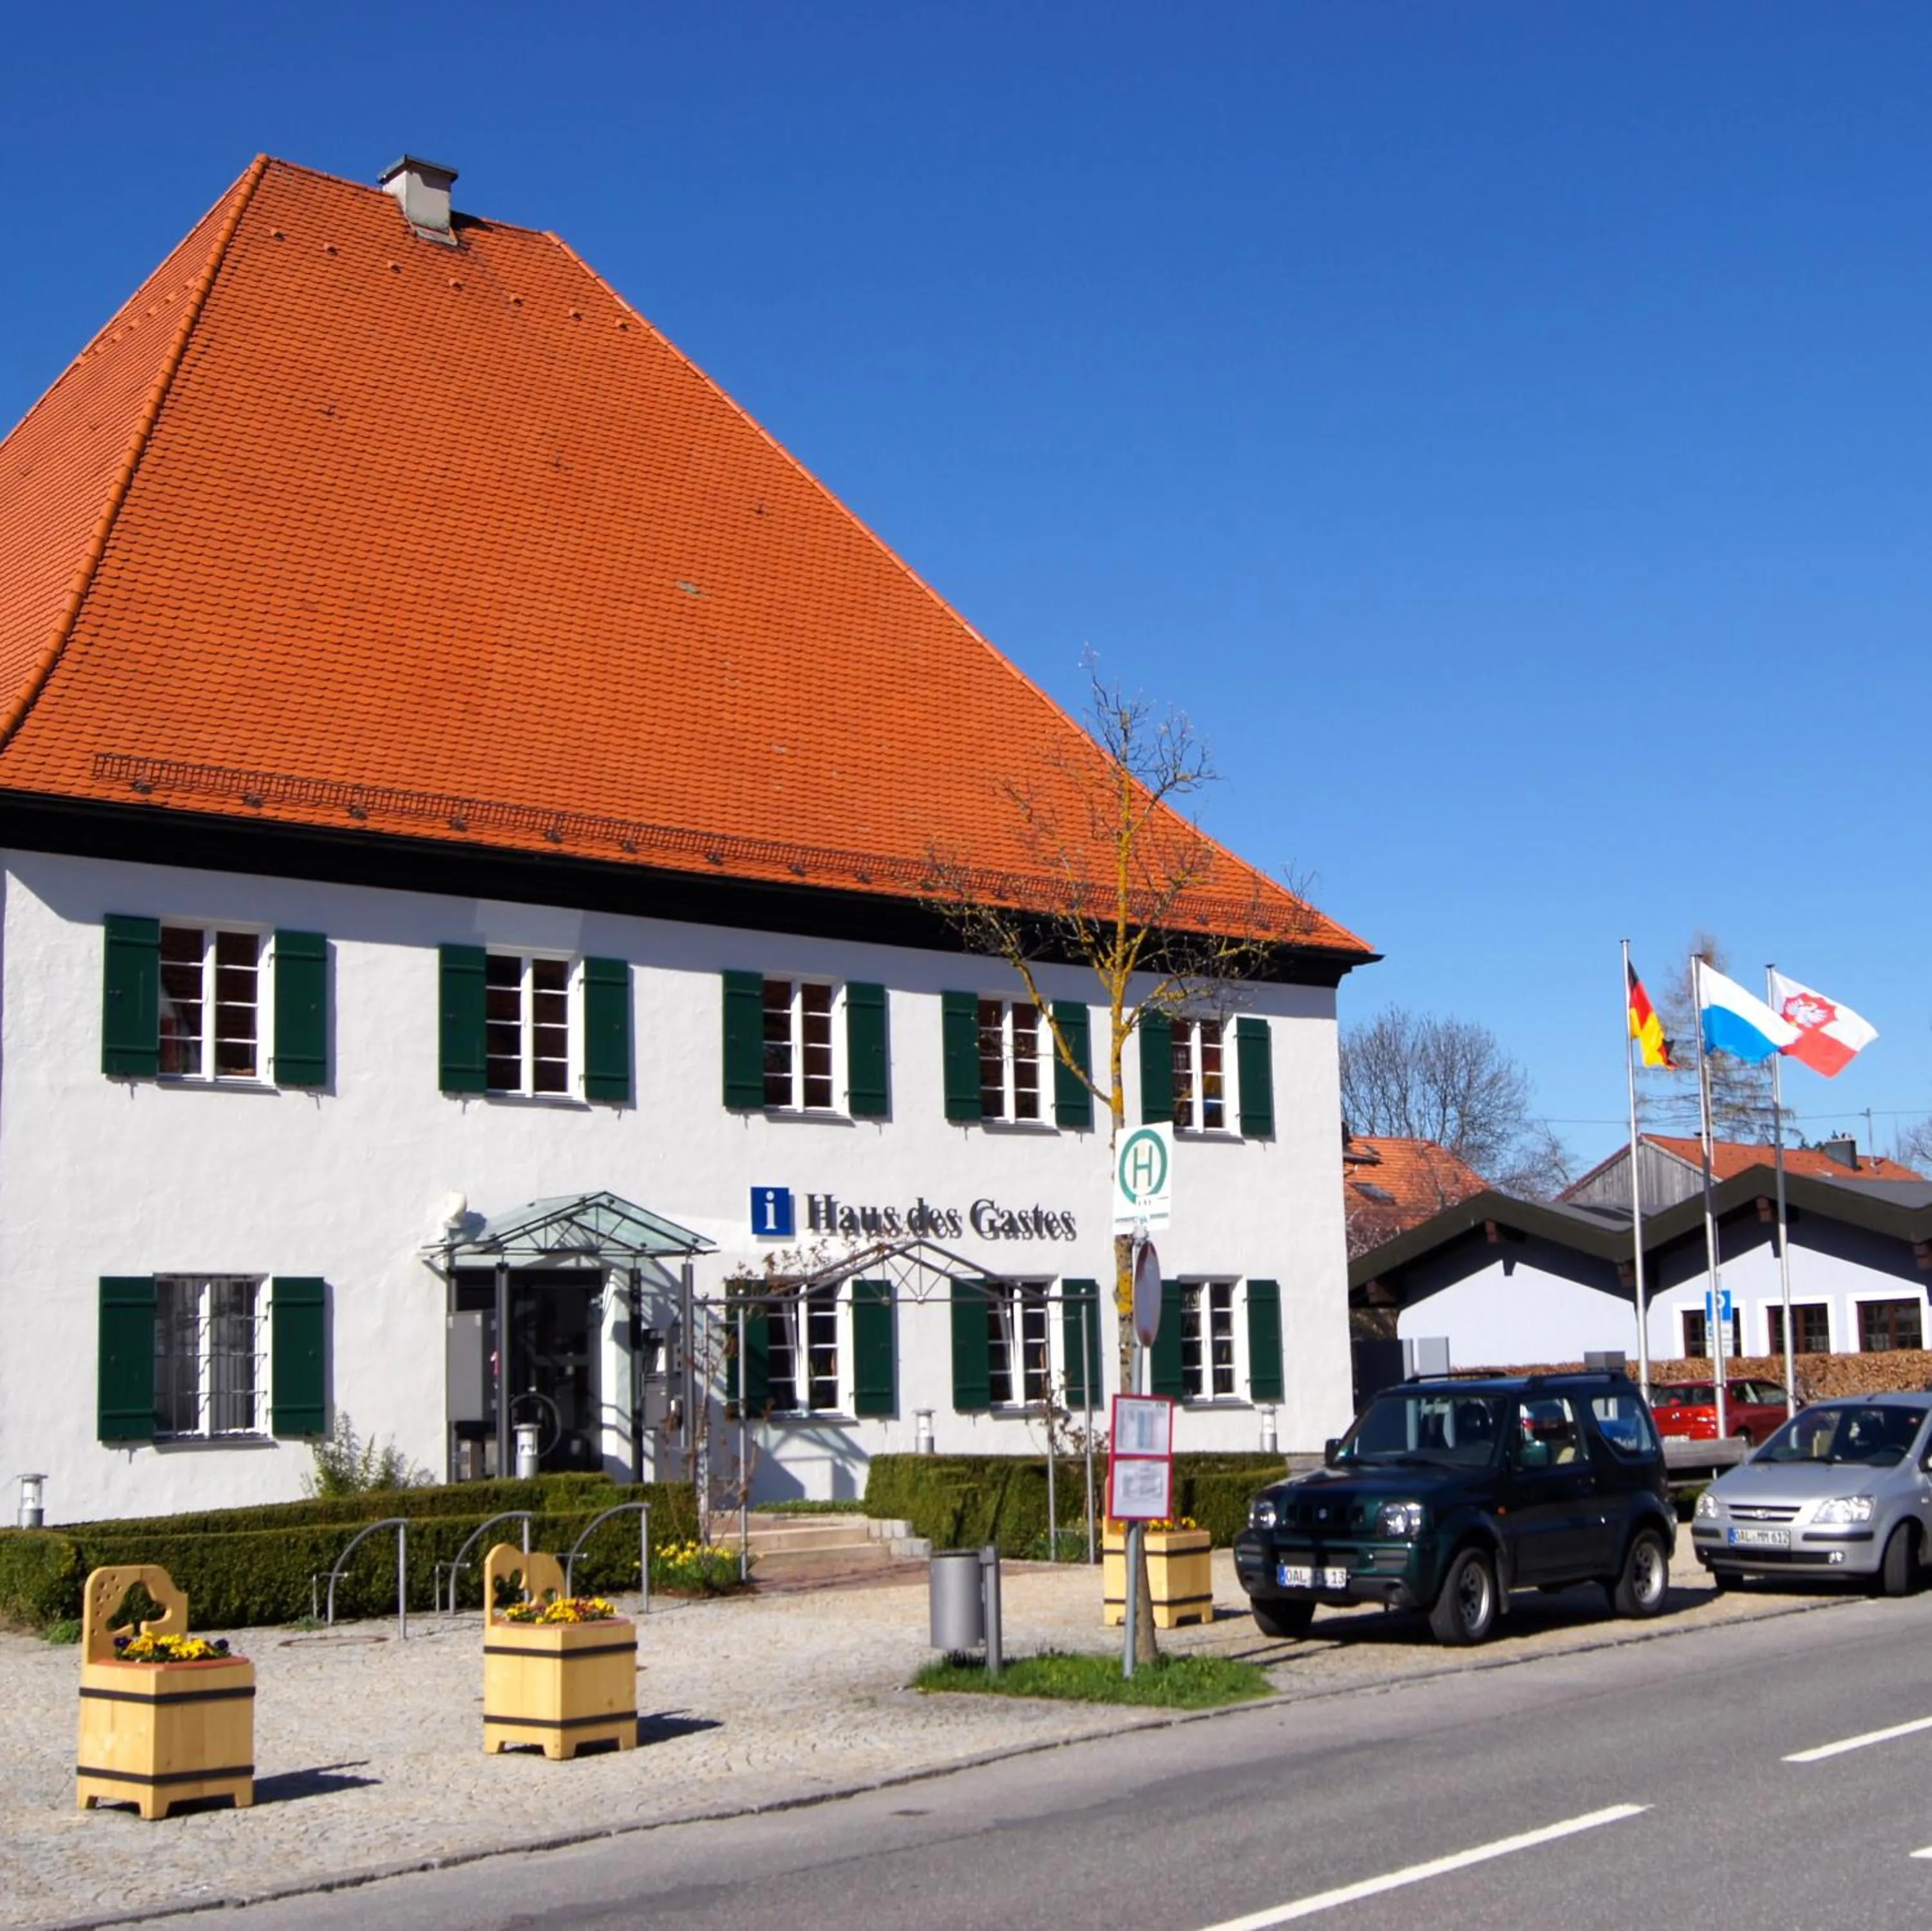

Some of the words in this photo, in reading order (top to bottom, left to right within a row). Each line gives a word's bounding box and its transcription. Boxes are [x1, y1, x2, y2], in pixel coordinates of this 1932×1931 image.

[1132, 1144, 1153, 1188] H
[764, 1191, 777, 1230] i
[804, 1193, 900, 1235] Haus
[906, 1197, 962, 1237] des
[969, 1199, 1077, 1241] Gastes
[1286, 1569, 1307, 1583] OAL
[1332, 1570, 1345, 1584] 13
